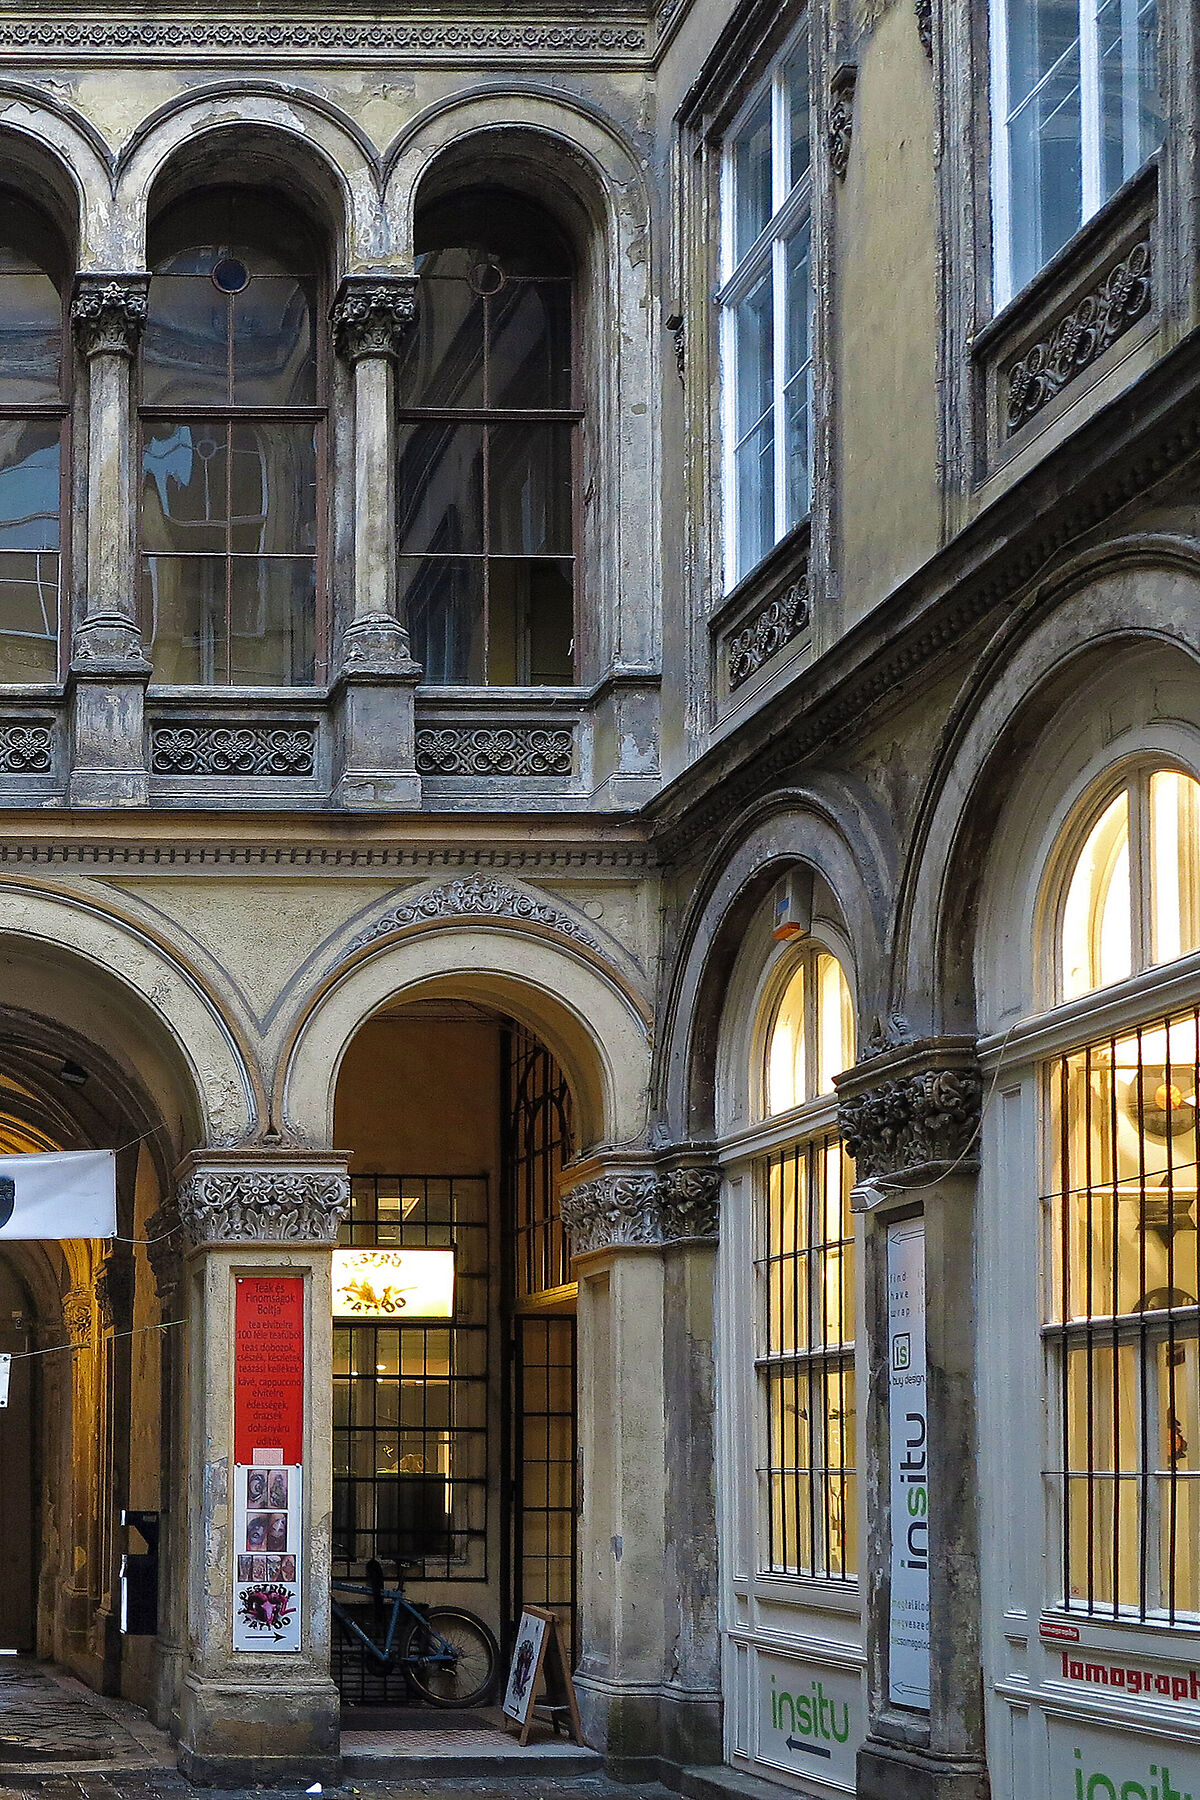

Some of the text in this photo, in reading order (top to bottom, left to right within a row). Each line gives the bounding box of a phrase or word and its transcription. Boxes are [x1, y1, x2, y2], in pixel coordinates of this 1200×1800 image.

[889, 1271, 907, 1283] find
[275, 1283, 285, 1293] és
[245, 1293, 295, 1305] Finomságok
[890, 1290, 909, 1300] have
[238, 1330, 252, 1339] 100
[892, 1375, 904, 1388] buy
[899, 1412, 928, 1570] insitu
[242, 1616, 292, 1631] TATTOO
[770, 1673, 850, 1744] insitu
